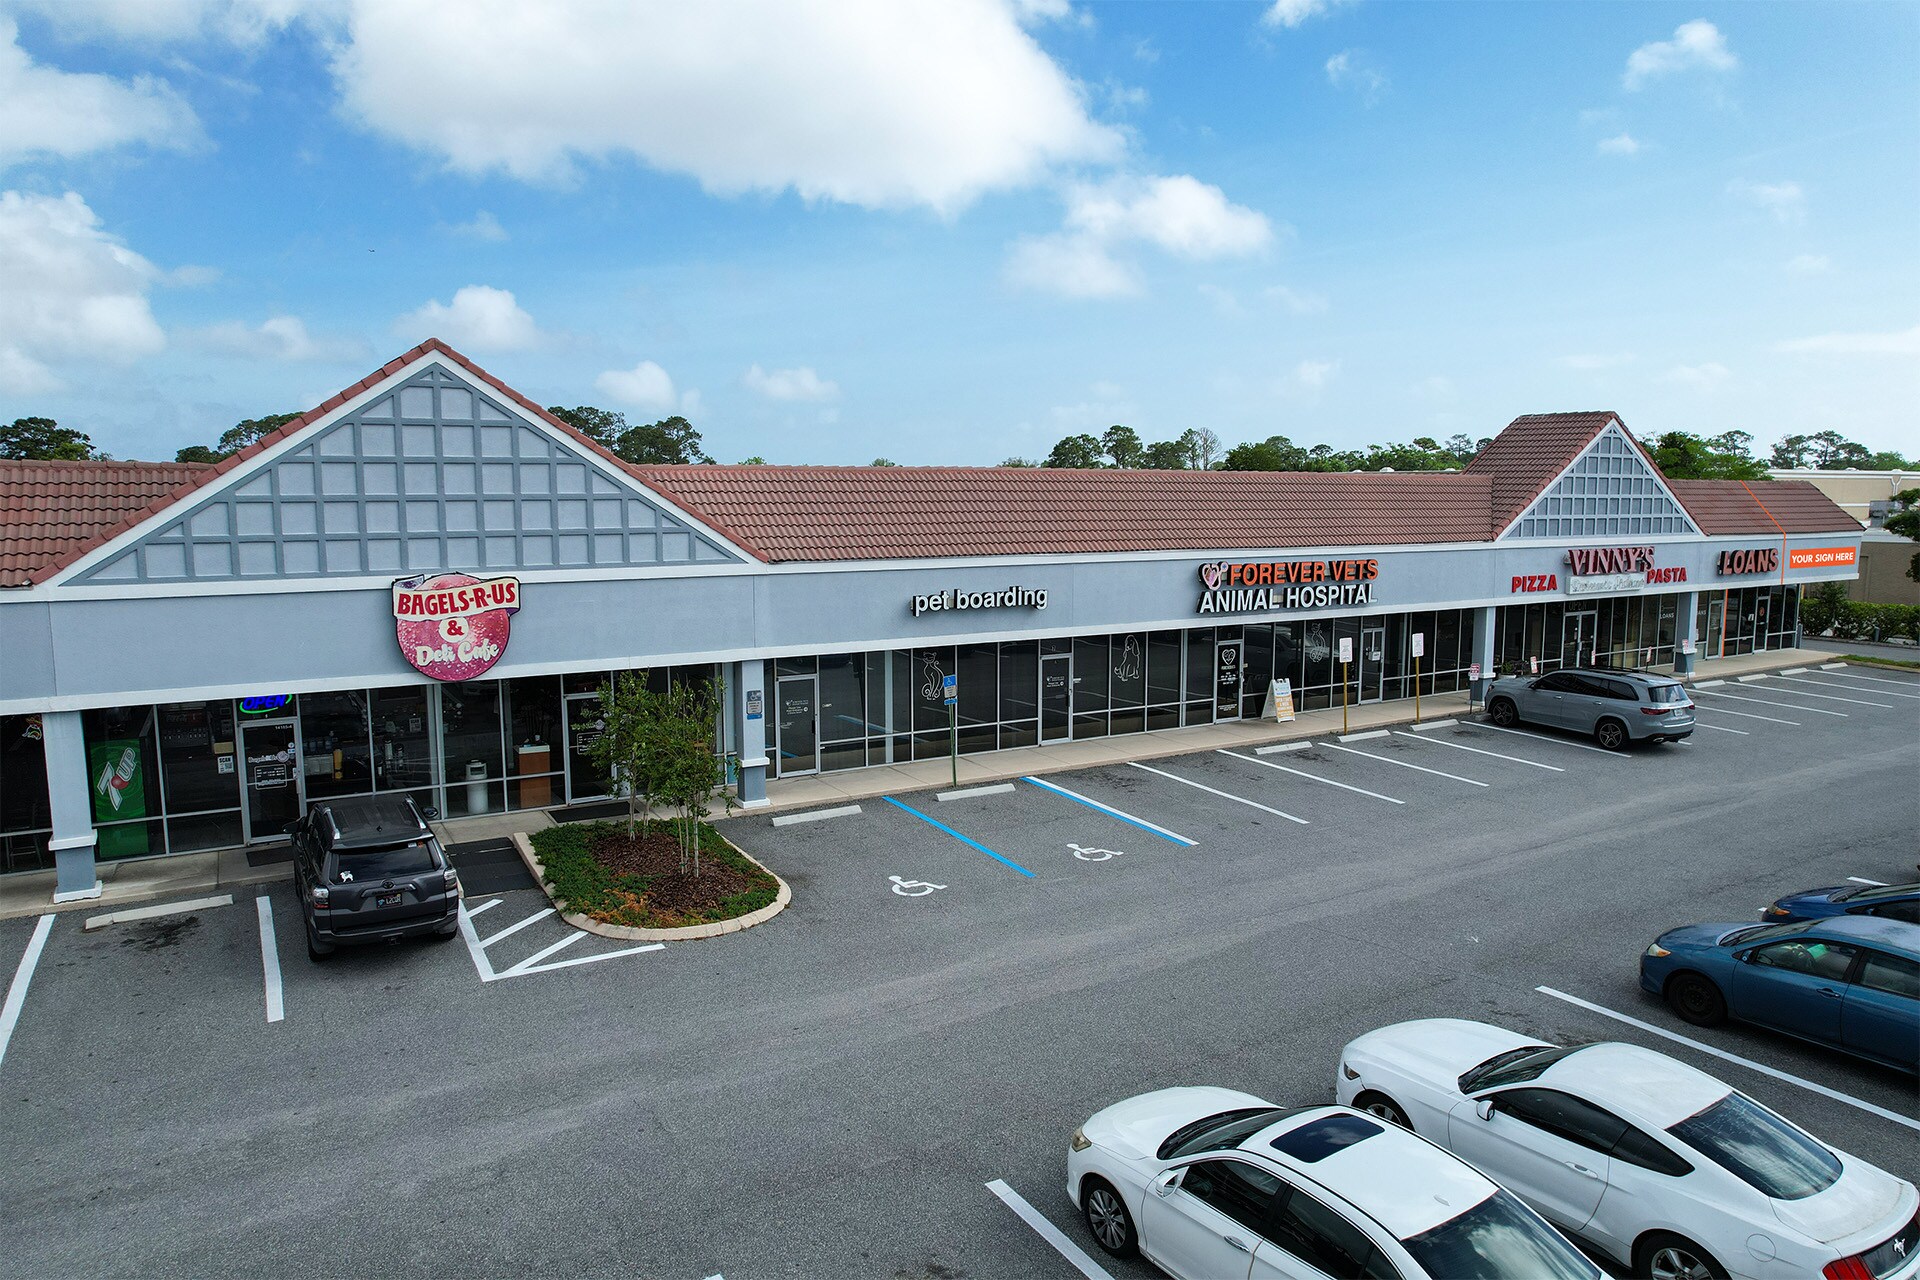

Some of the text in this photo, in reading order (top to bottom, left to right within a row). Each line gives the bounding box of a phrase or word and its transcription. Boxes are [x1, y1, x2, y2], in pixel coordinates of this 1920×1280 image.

[1228, 559, 1379, 587] FOREVER VETS
[1568, 546, 1655, 576] VINNY'S
[1719, 548, 1779, 575] LOANS
[1512, 575, 1558, 593] PIZZA
[1646, 567, 1687, 584] PASTA
[912, 586, 1048, 617] pet boarding
[1197, 584, 1379, 614] ANIMAL HOSPITAL
[446, 620, 464, 636] &
[415, 644, 456, 667] Deli
[243, 694, 286, 710] OPEN
